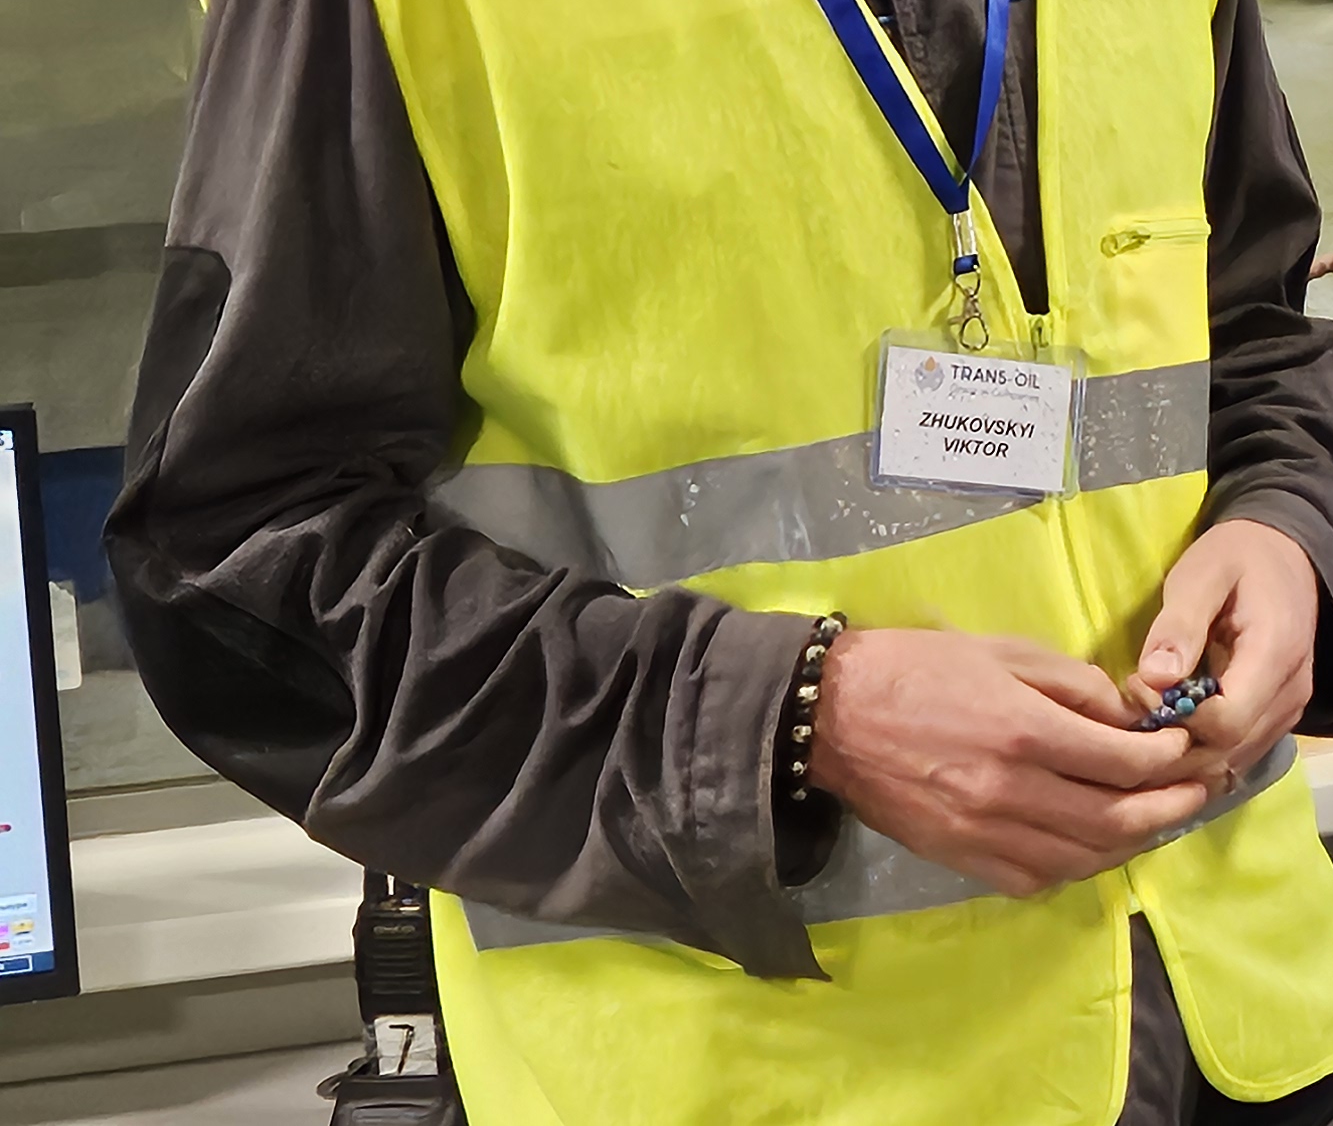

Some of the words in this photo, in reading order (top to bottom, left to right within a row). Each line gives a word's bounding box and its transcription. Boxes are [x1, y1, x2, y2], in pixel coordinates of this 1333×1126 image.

[918, 411, 1036, 439] ZHUKOVSKYI
[943, 437, 1010, 458] VIKTOR
[388, 1023, 415, 1074] 7
